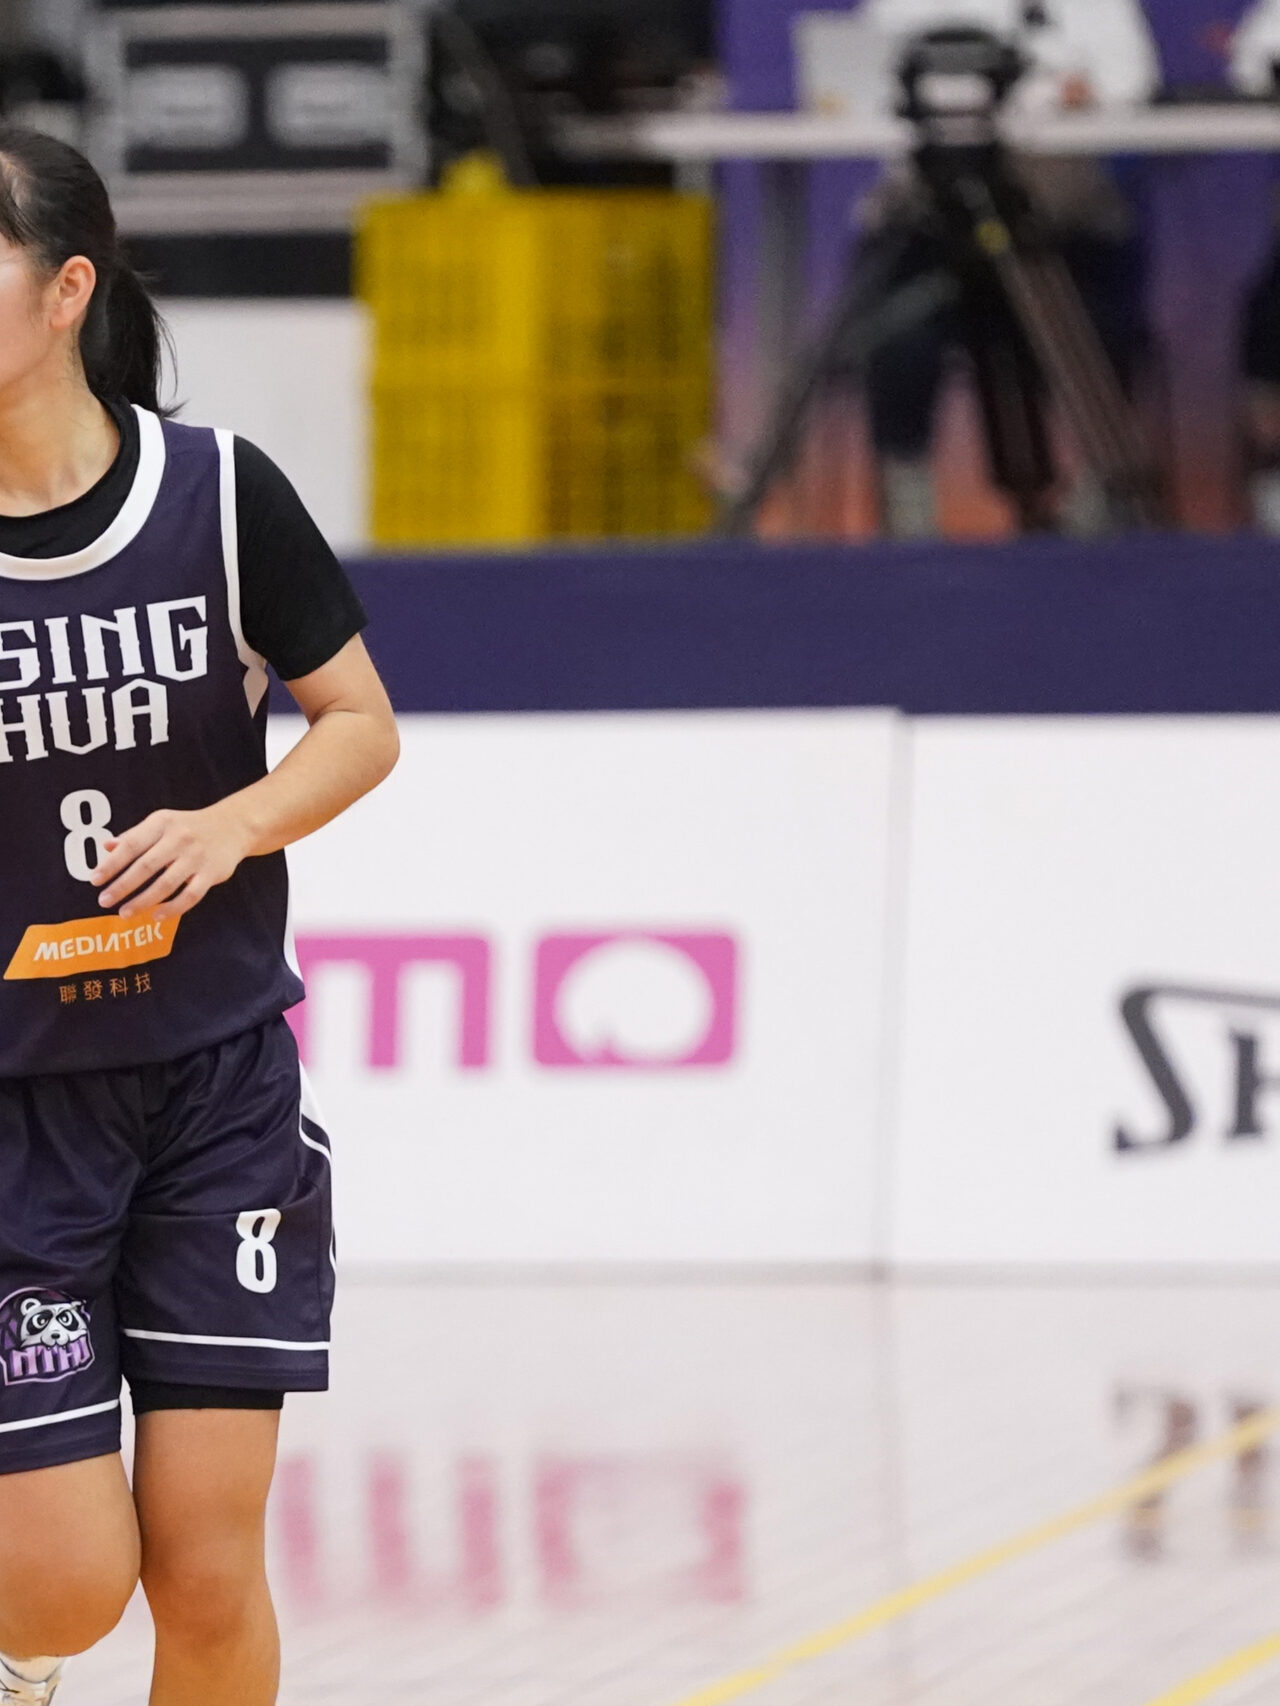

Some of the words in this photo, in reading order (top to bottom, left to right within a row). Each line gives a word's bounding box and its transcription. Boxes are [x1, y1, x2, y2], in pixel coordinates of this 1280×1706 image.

[60, 789, 116, 882] 8
[33, 922, 163, 962] MEDIATEK
[59, 972, 152, 1004] 聯發科技
[235, 1208, 281, 1294] 8
